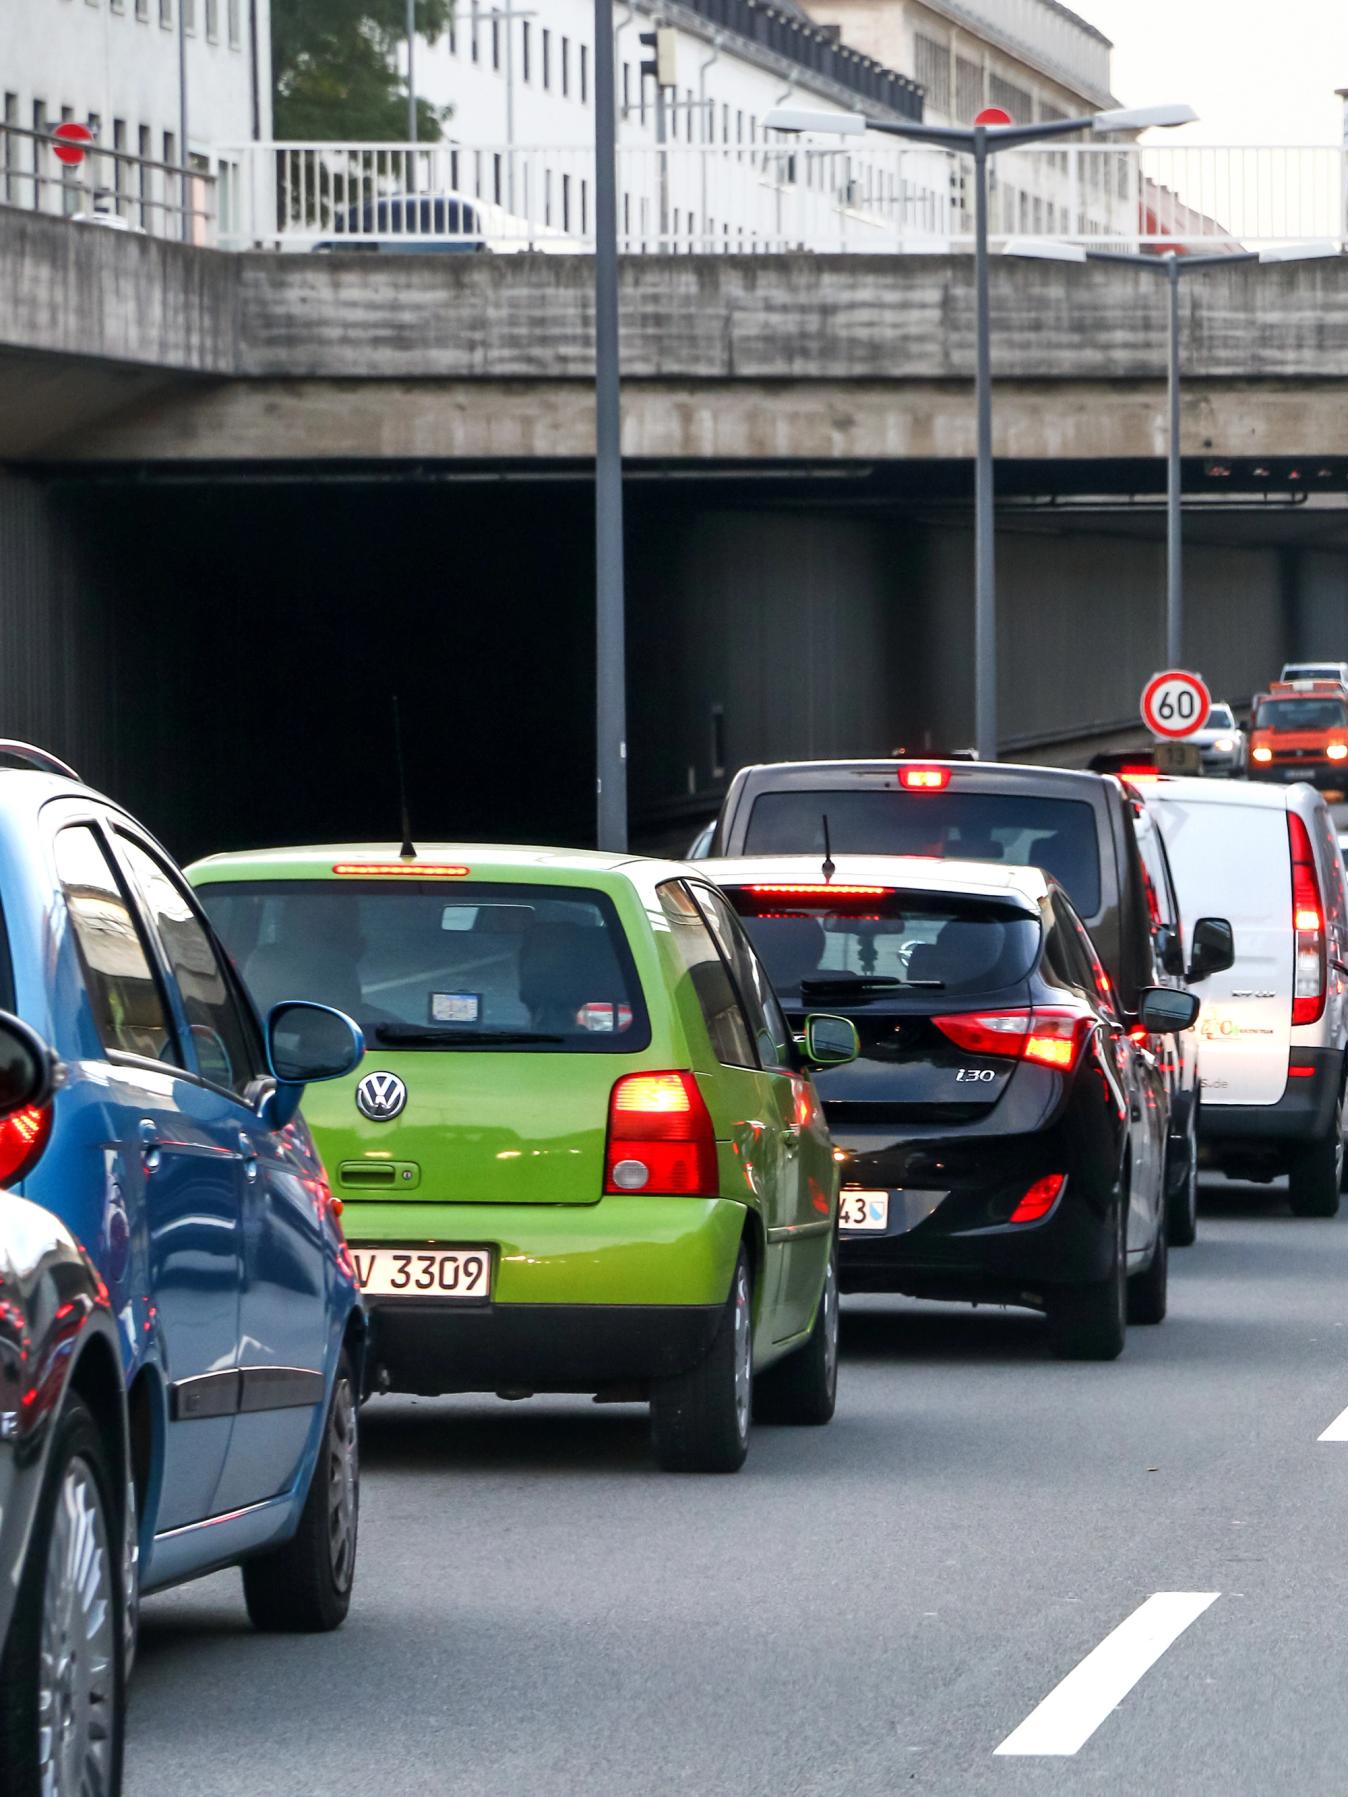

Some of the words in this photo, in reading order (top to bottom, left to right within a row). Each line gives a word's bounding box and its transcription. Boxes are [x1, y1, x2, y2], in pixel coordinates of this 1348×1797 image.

[1159, 691, 1193, 719] 60
[956, 1069, 995, 1082] i30
[390, 1254, 484, 1291] 3309
